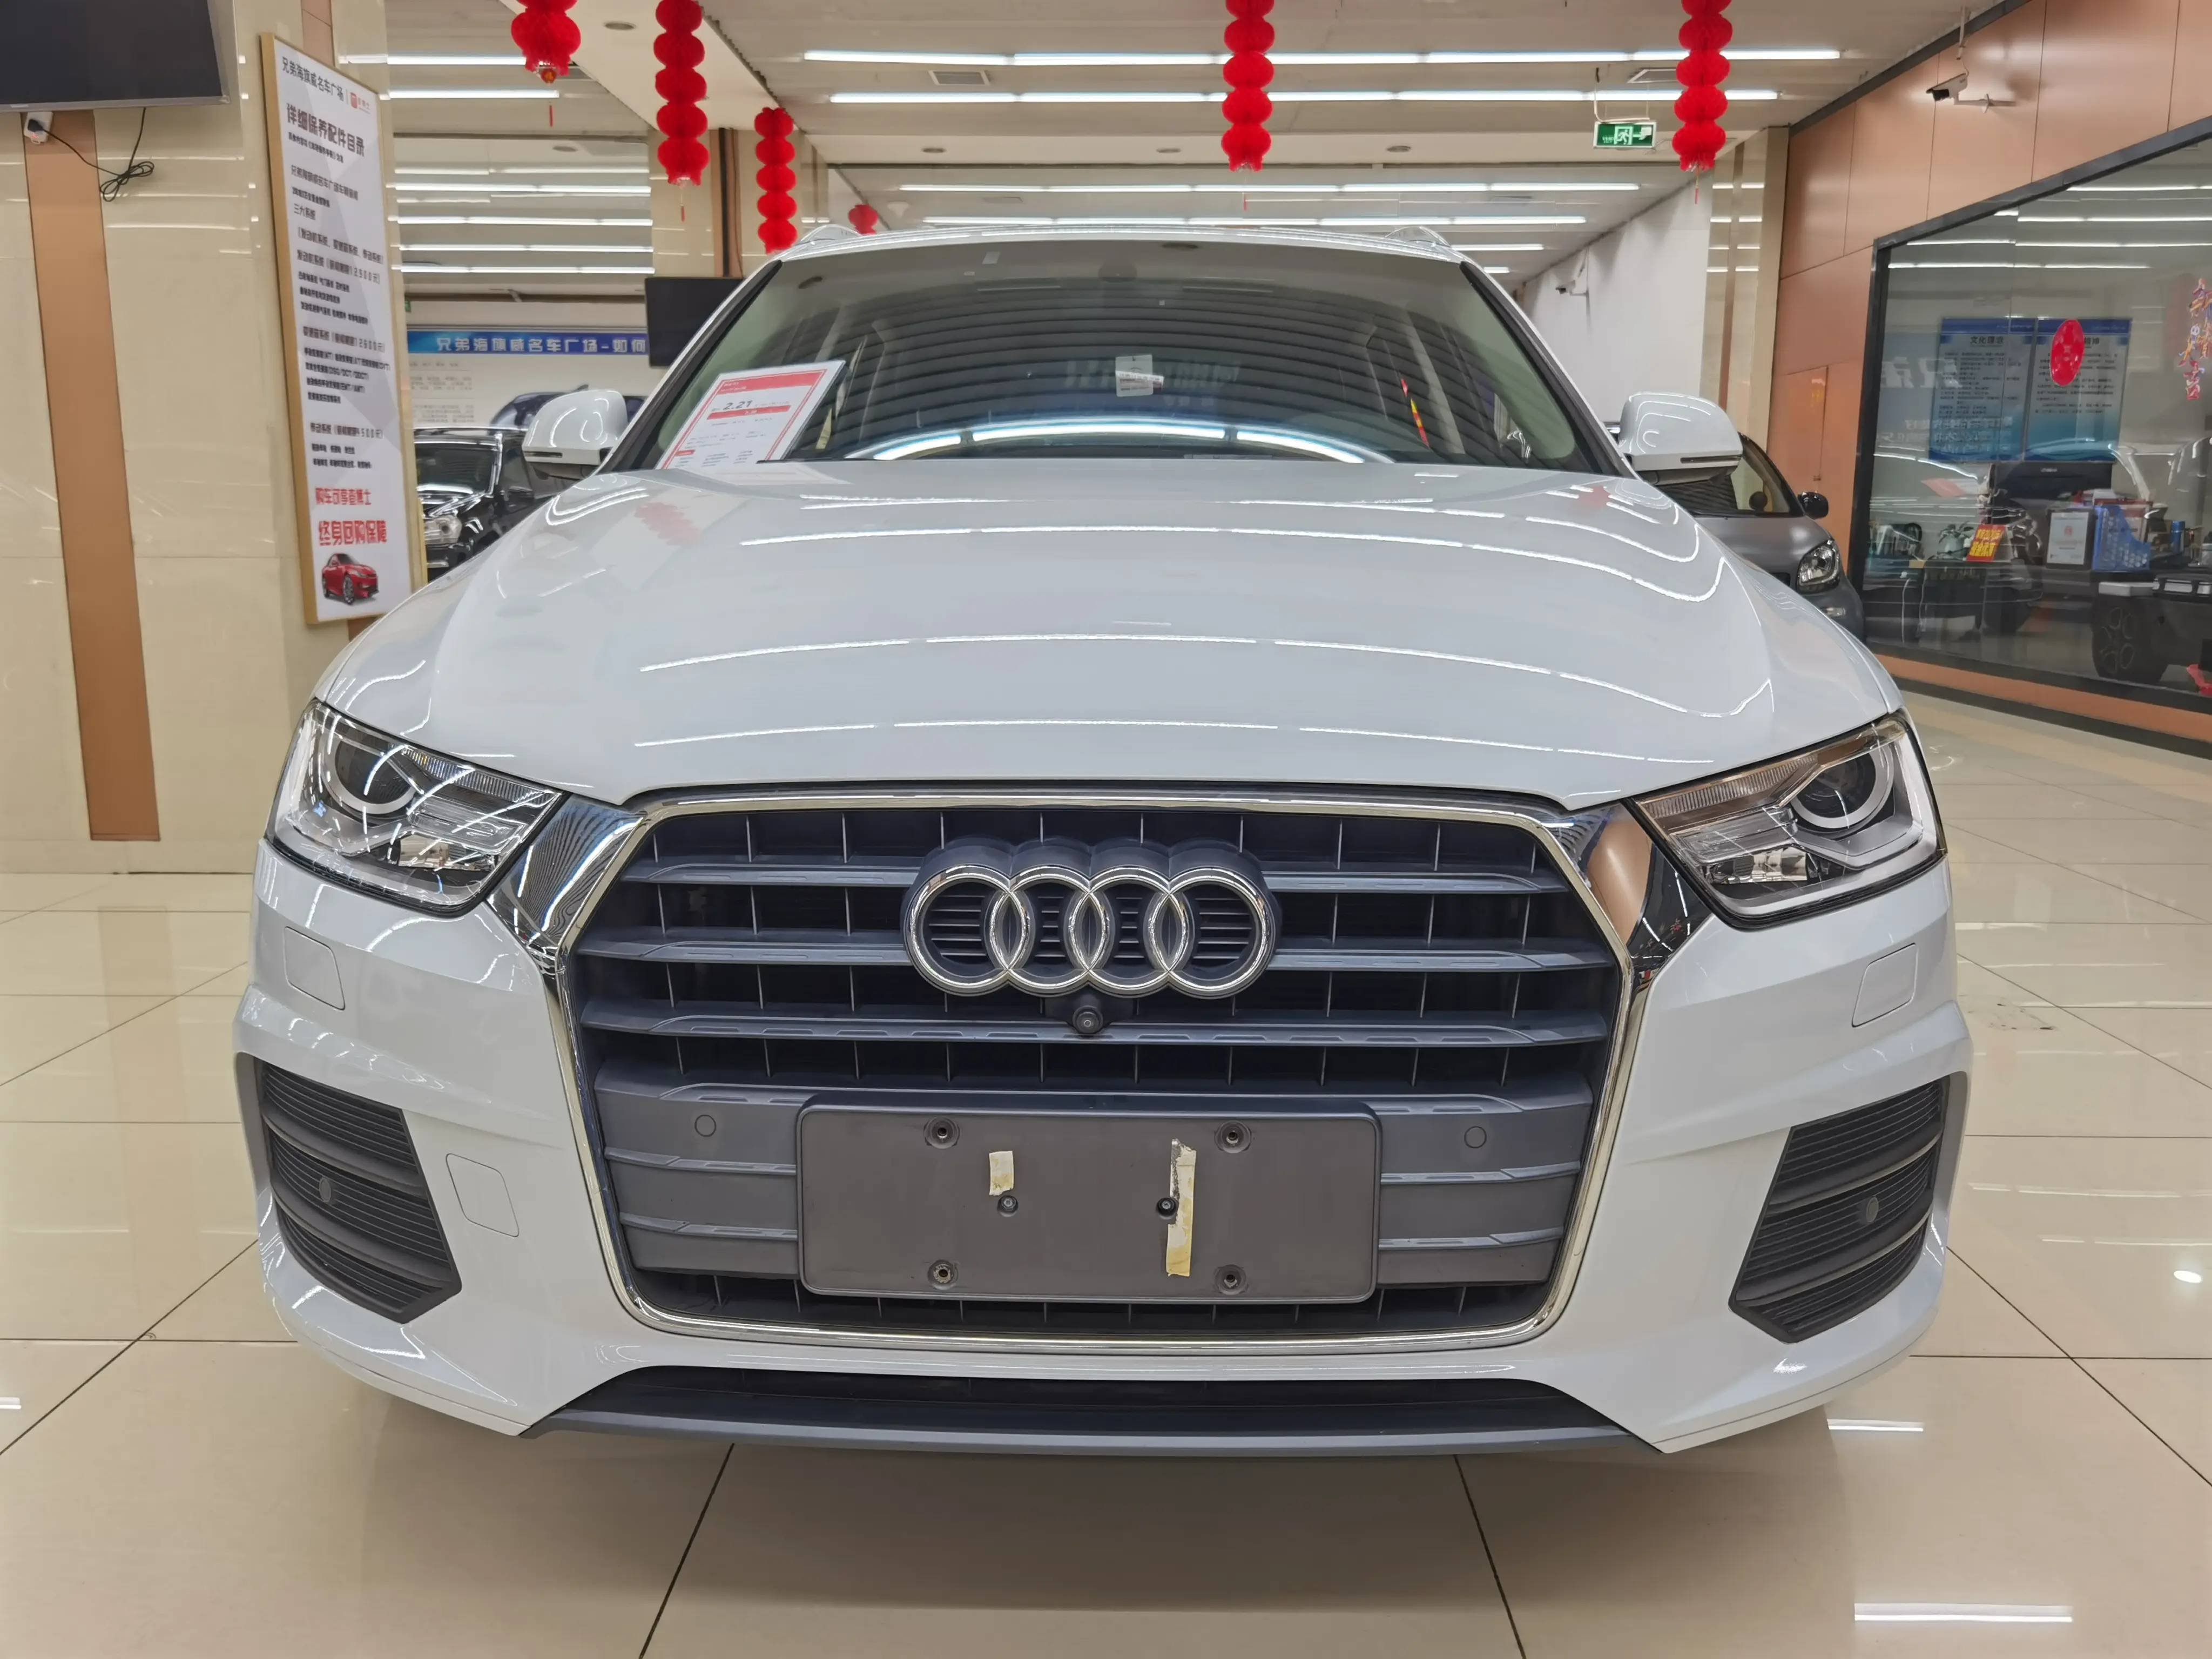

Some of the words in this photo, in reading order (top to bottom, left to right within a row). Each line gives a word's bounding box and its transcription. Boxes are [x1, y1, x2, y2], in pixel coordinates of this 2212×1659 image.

[282, 56, 344, 102] 兄弟海旗威名车广场
[286, 103, 365, 157] 详细保养配件目录
[723, 400, 753, 410] 2.21
[319, 520, 387, 546] 终身回购保障
